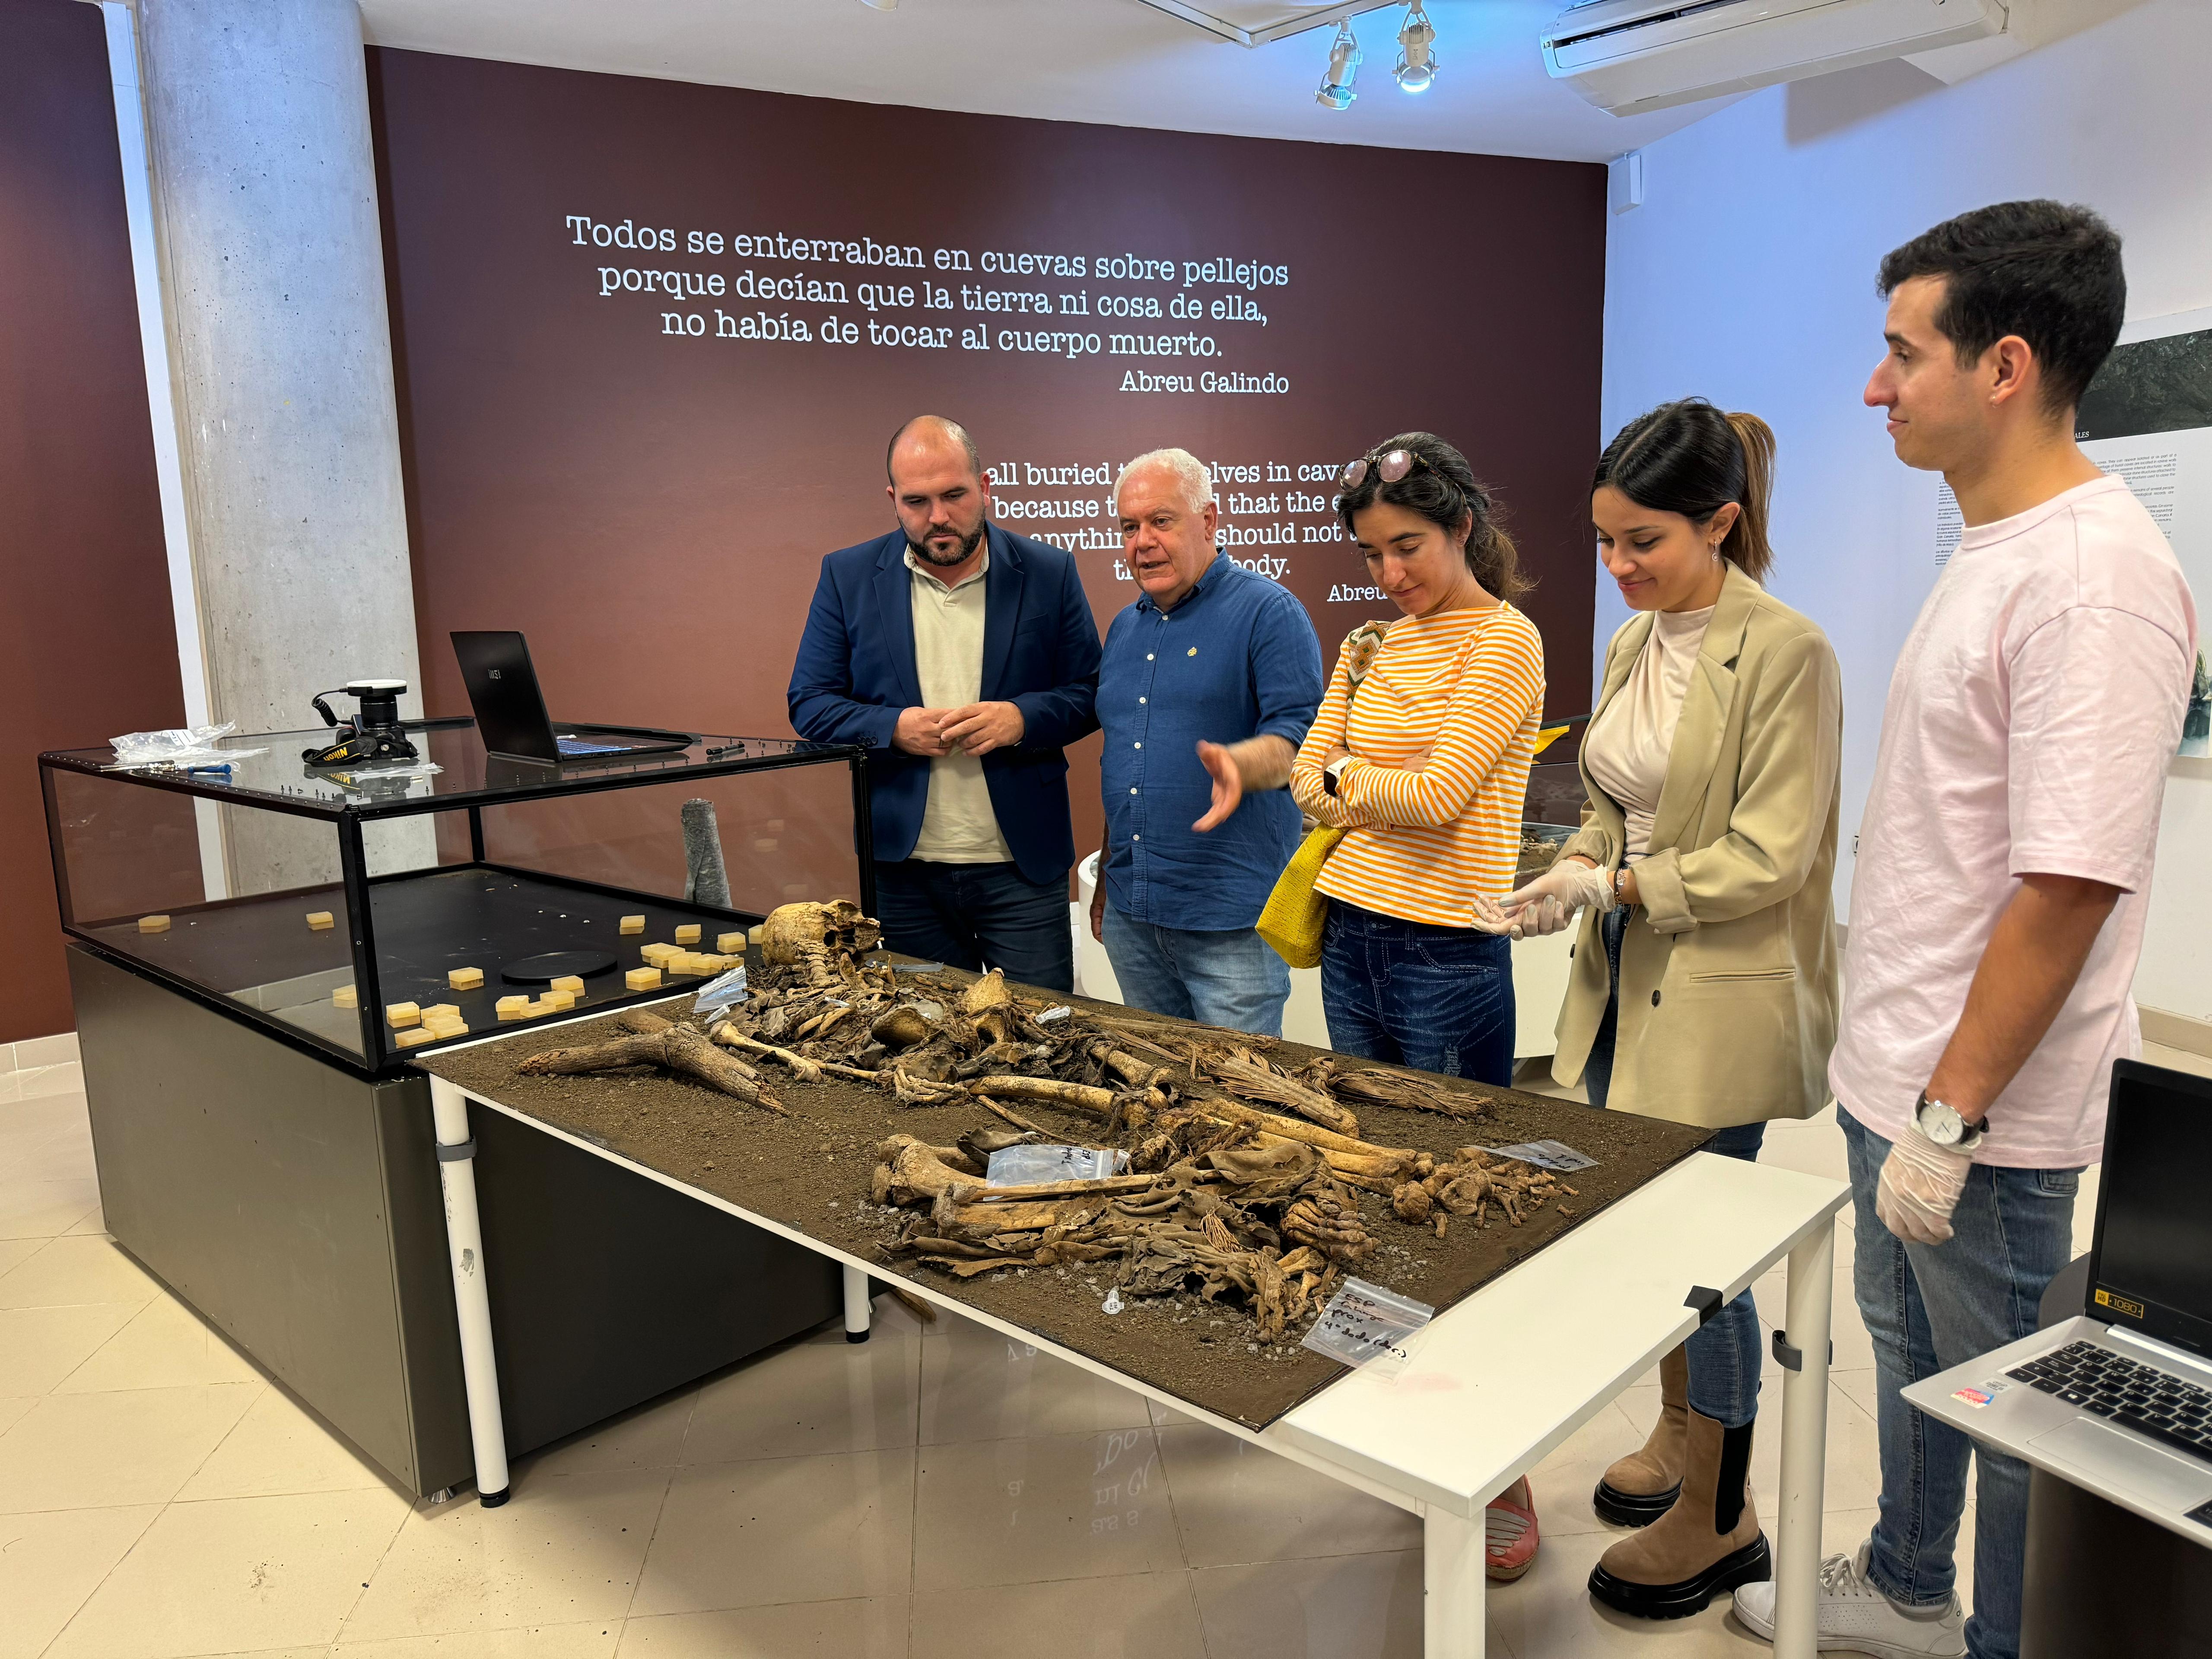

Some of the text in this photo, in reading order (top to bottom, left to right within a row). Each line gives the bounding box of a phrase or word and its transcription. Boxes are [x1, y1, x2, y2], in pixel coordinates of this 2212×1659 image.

[566, 216, 1288, 290] Todos se enterraban en cuevas sobre pellejos
[598, 268, 1267, 326] porque decían que la tierra ni cosa de ella,
[661, 309, 1222, 359] no había de tocar al cuerpo muerto.
[1119, 370, 1289, 394] Abreu Galindo
[986, 462, 1020, 486] all
[1024, 462, 1112, 486] buried
[1267, 461, 1292, 482] in
[1298, 464, 1339, 482] cav
[992, 496, 1099, 519] because
[1228, 492, 1280, 515] that
[1285, 491, 1325, 513] the
[1215, 522, 1297, 547] should
[1302, 521, 1342, 543] not
[1327, 584, 1388, 602] Abreu
[323, 747, 348, 761] Nikon
[2113, 1298, 2137, 1313] 1080
